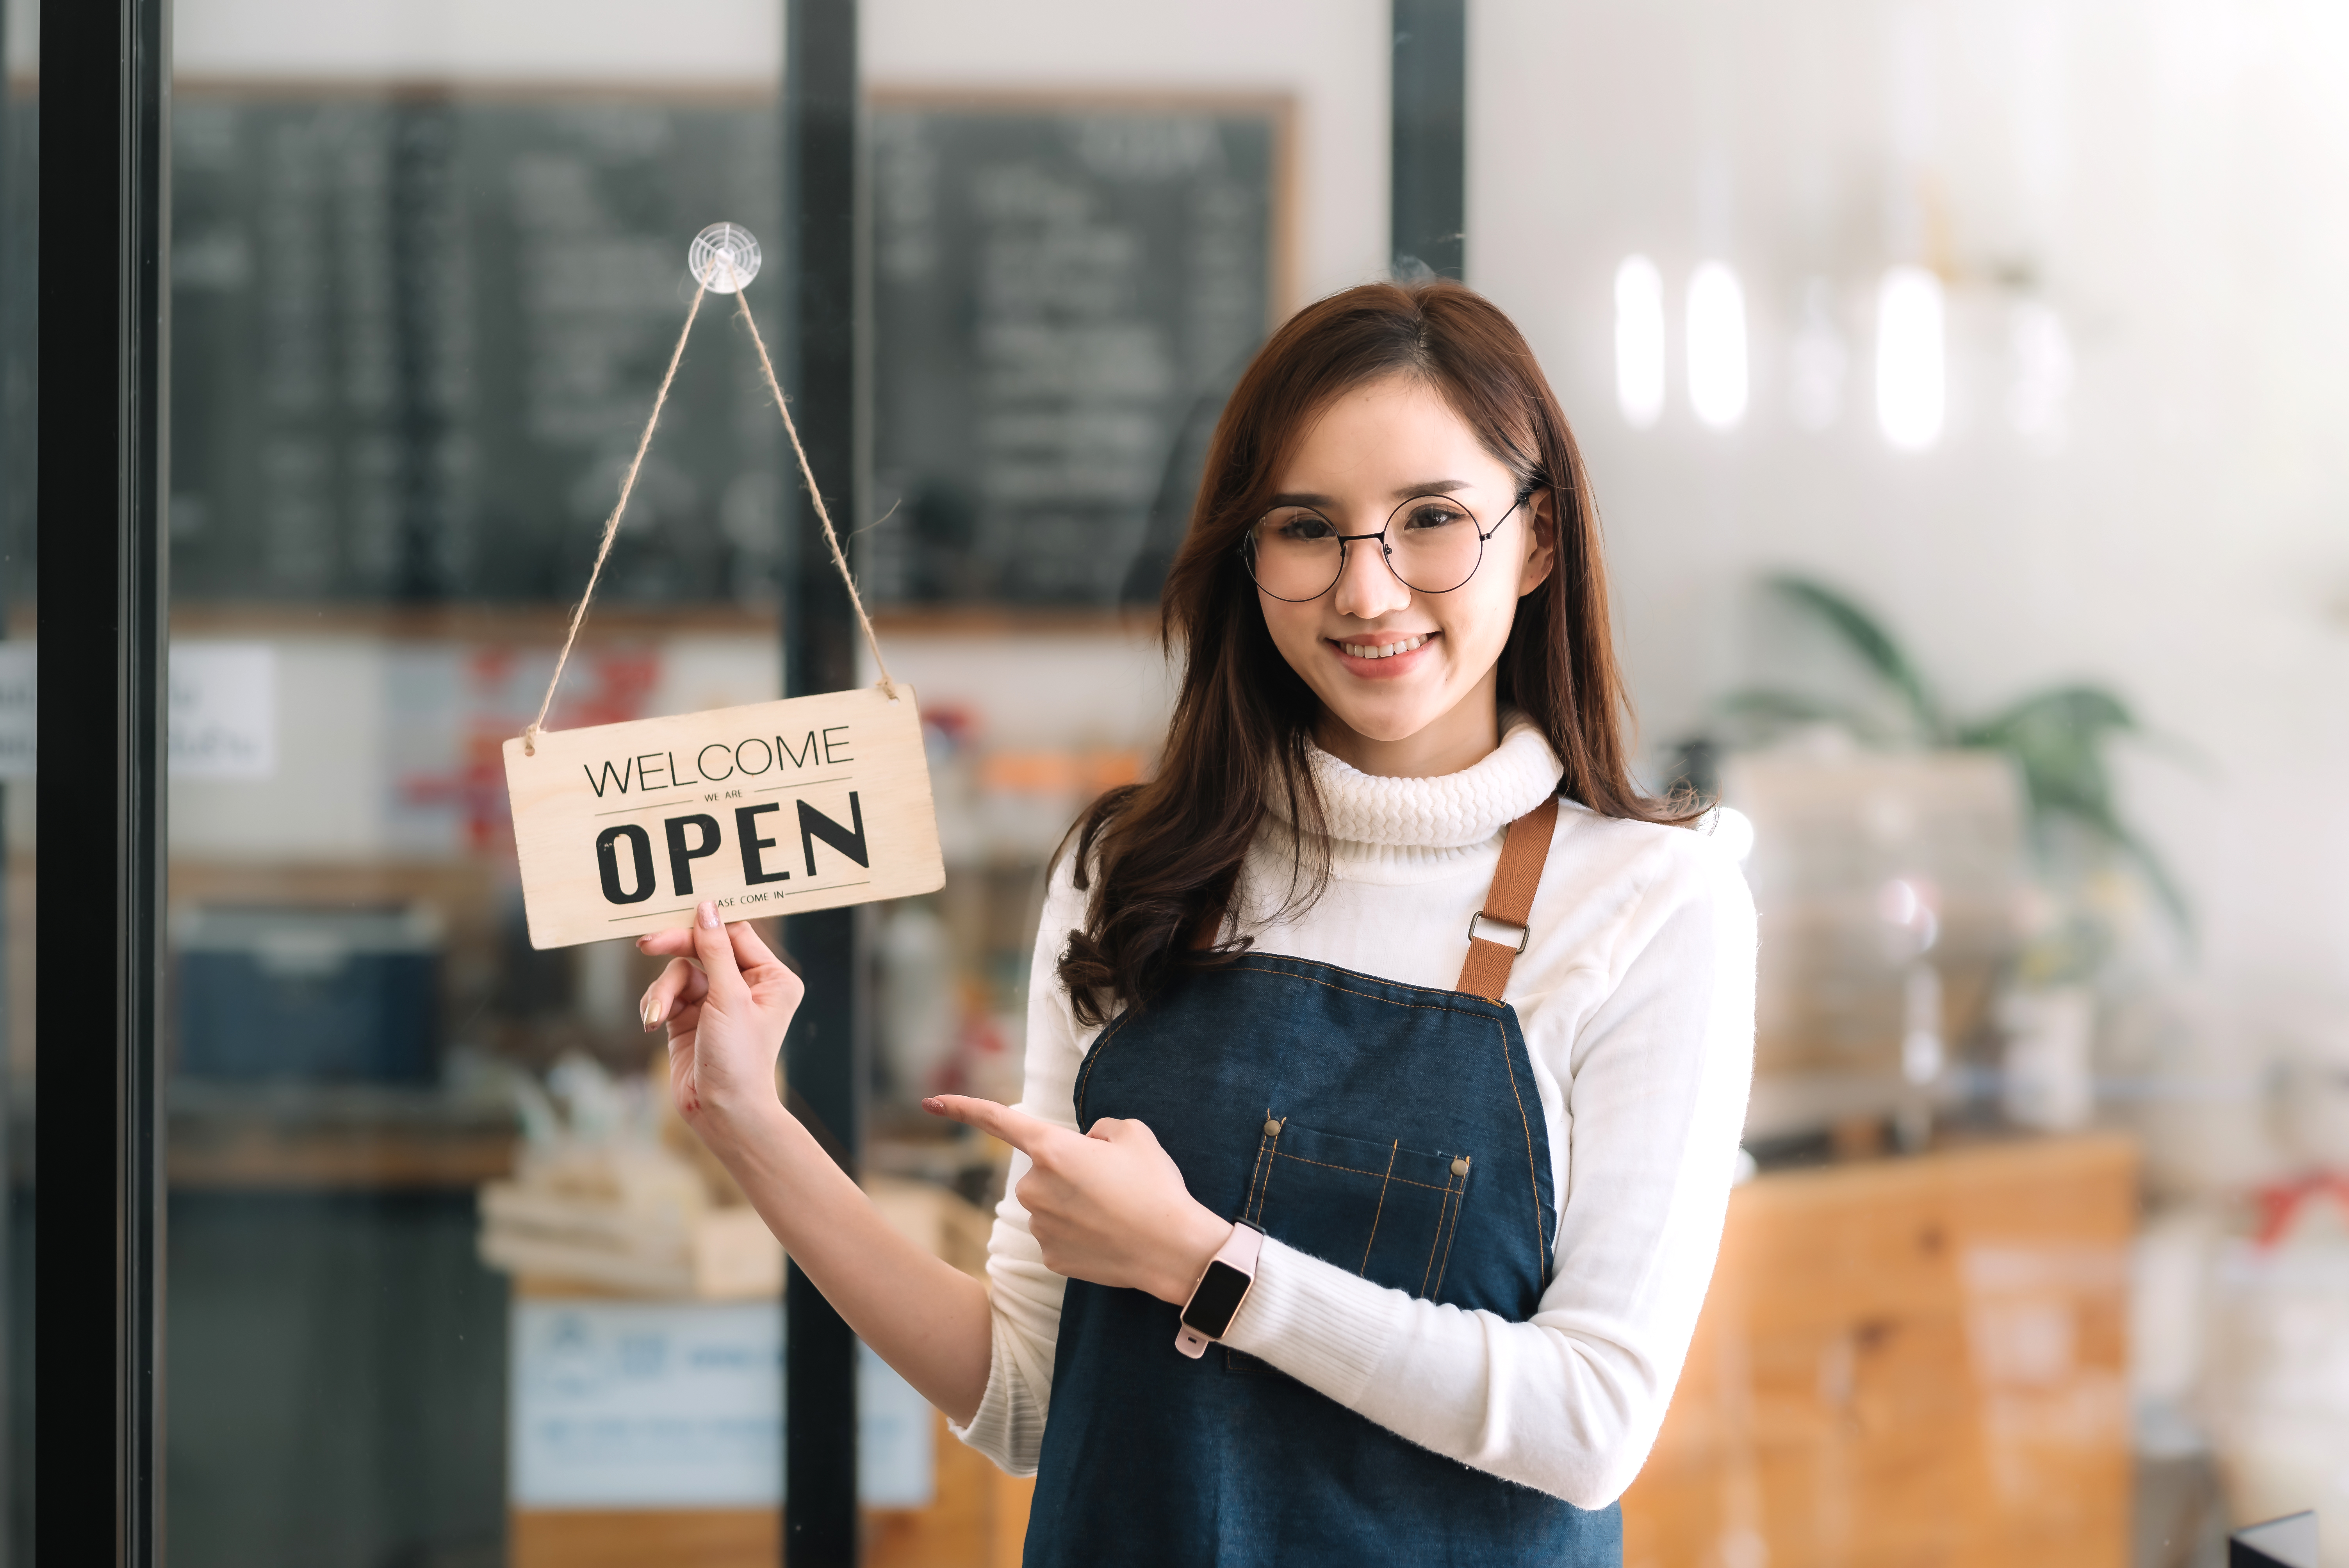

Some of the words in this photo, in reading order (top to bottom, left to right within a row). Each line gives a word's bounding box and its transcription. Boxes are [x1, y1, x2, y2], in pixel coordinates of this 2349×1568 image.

[584, 726, 854, 798] WELCOME
[704, 792, 719, 802] WE
[725, 789, 743, 799] ARE
[595, 791, 870, 905] OPEN
[740, 893, 768, 904] COME
[774, 891, 784, 899] IN
